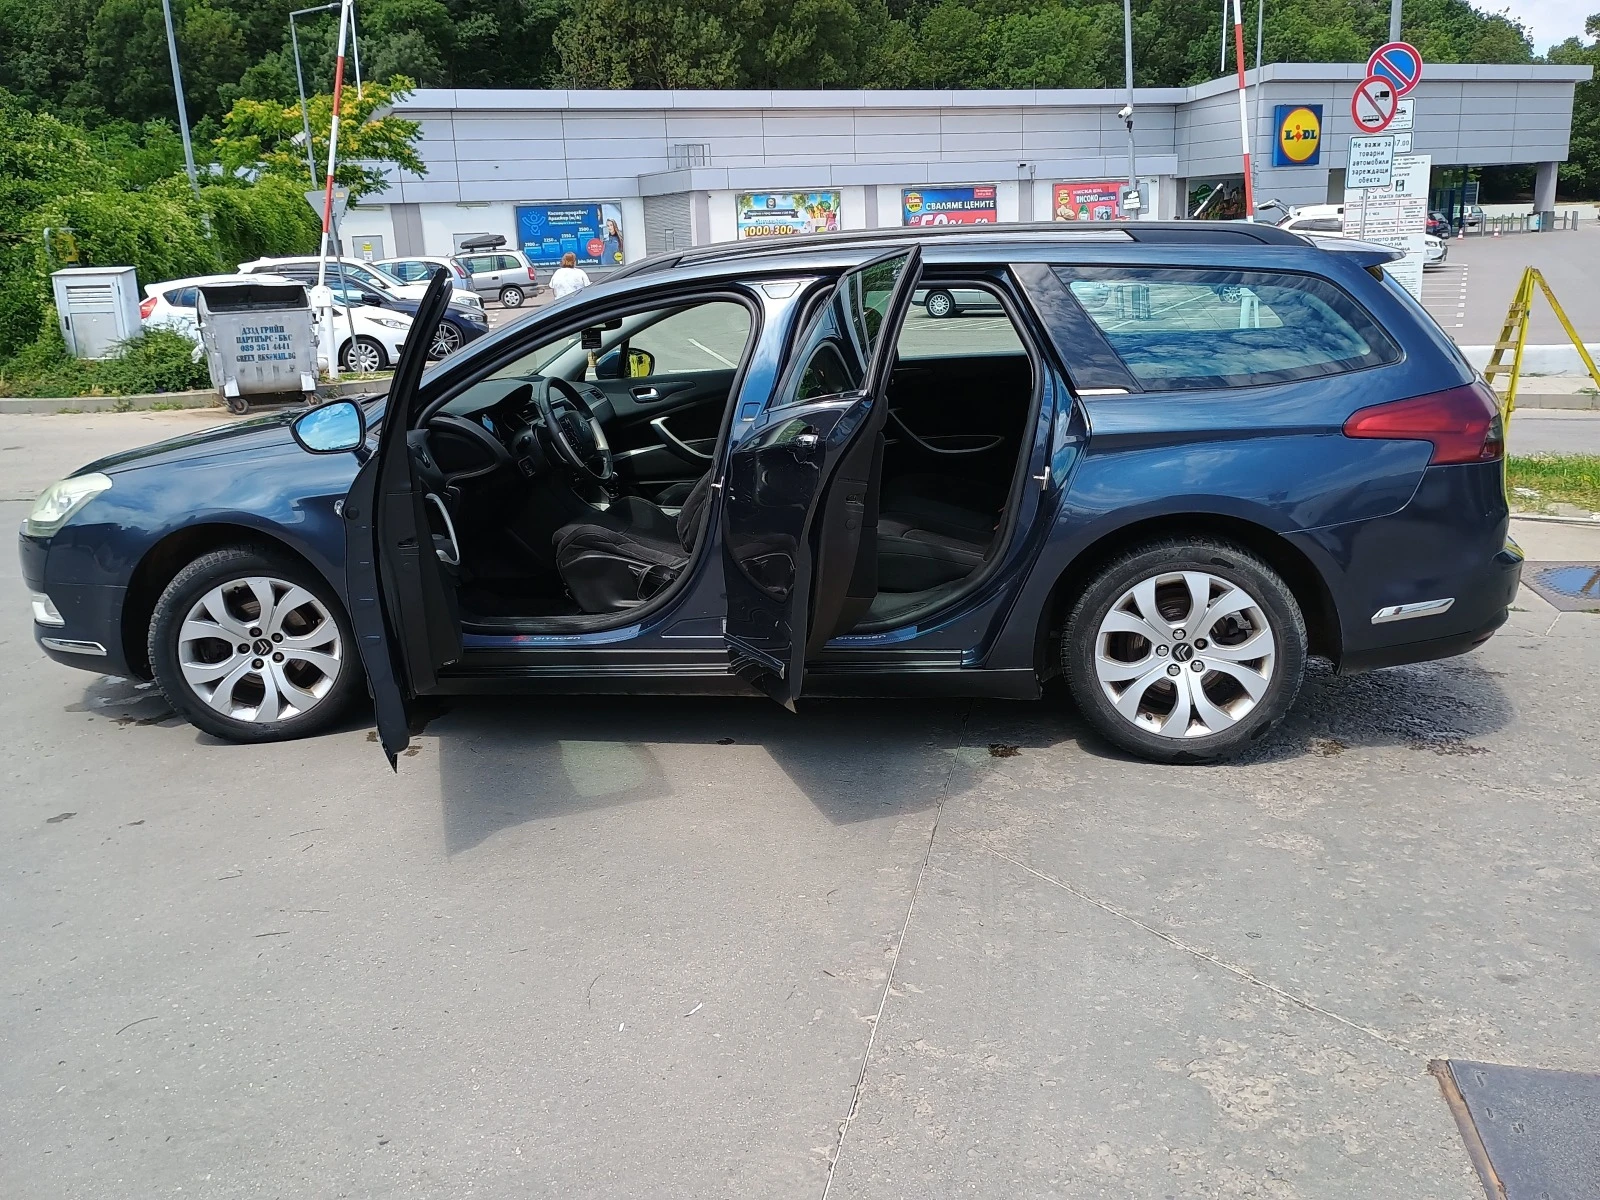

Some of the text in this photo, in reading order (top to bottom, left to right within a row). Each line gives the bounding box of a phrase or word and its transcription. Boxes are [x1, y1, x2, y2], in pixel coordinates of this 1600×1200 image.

[1284, 124, 1317, 142] LIDL
[1394, 139, 1410, 147] 7.00
[1351, 168, 1389, 176] зареждащи
[1076, 194, 1099, 204] ВИСОКО
[925, 200, 994, 210] СВАЛЯМЕ ЦЕНИТЕ
[745, 226, 770, 236] 1000
[774, 224, 793, 235] 300
[240, 344, 255, 352] 089
[256, 343, 270, 352] 361
